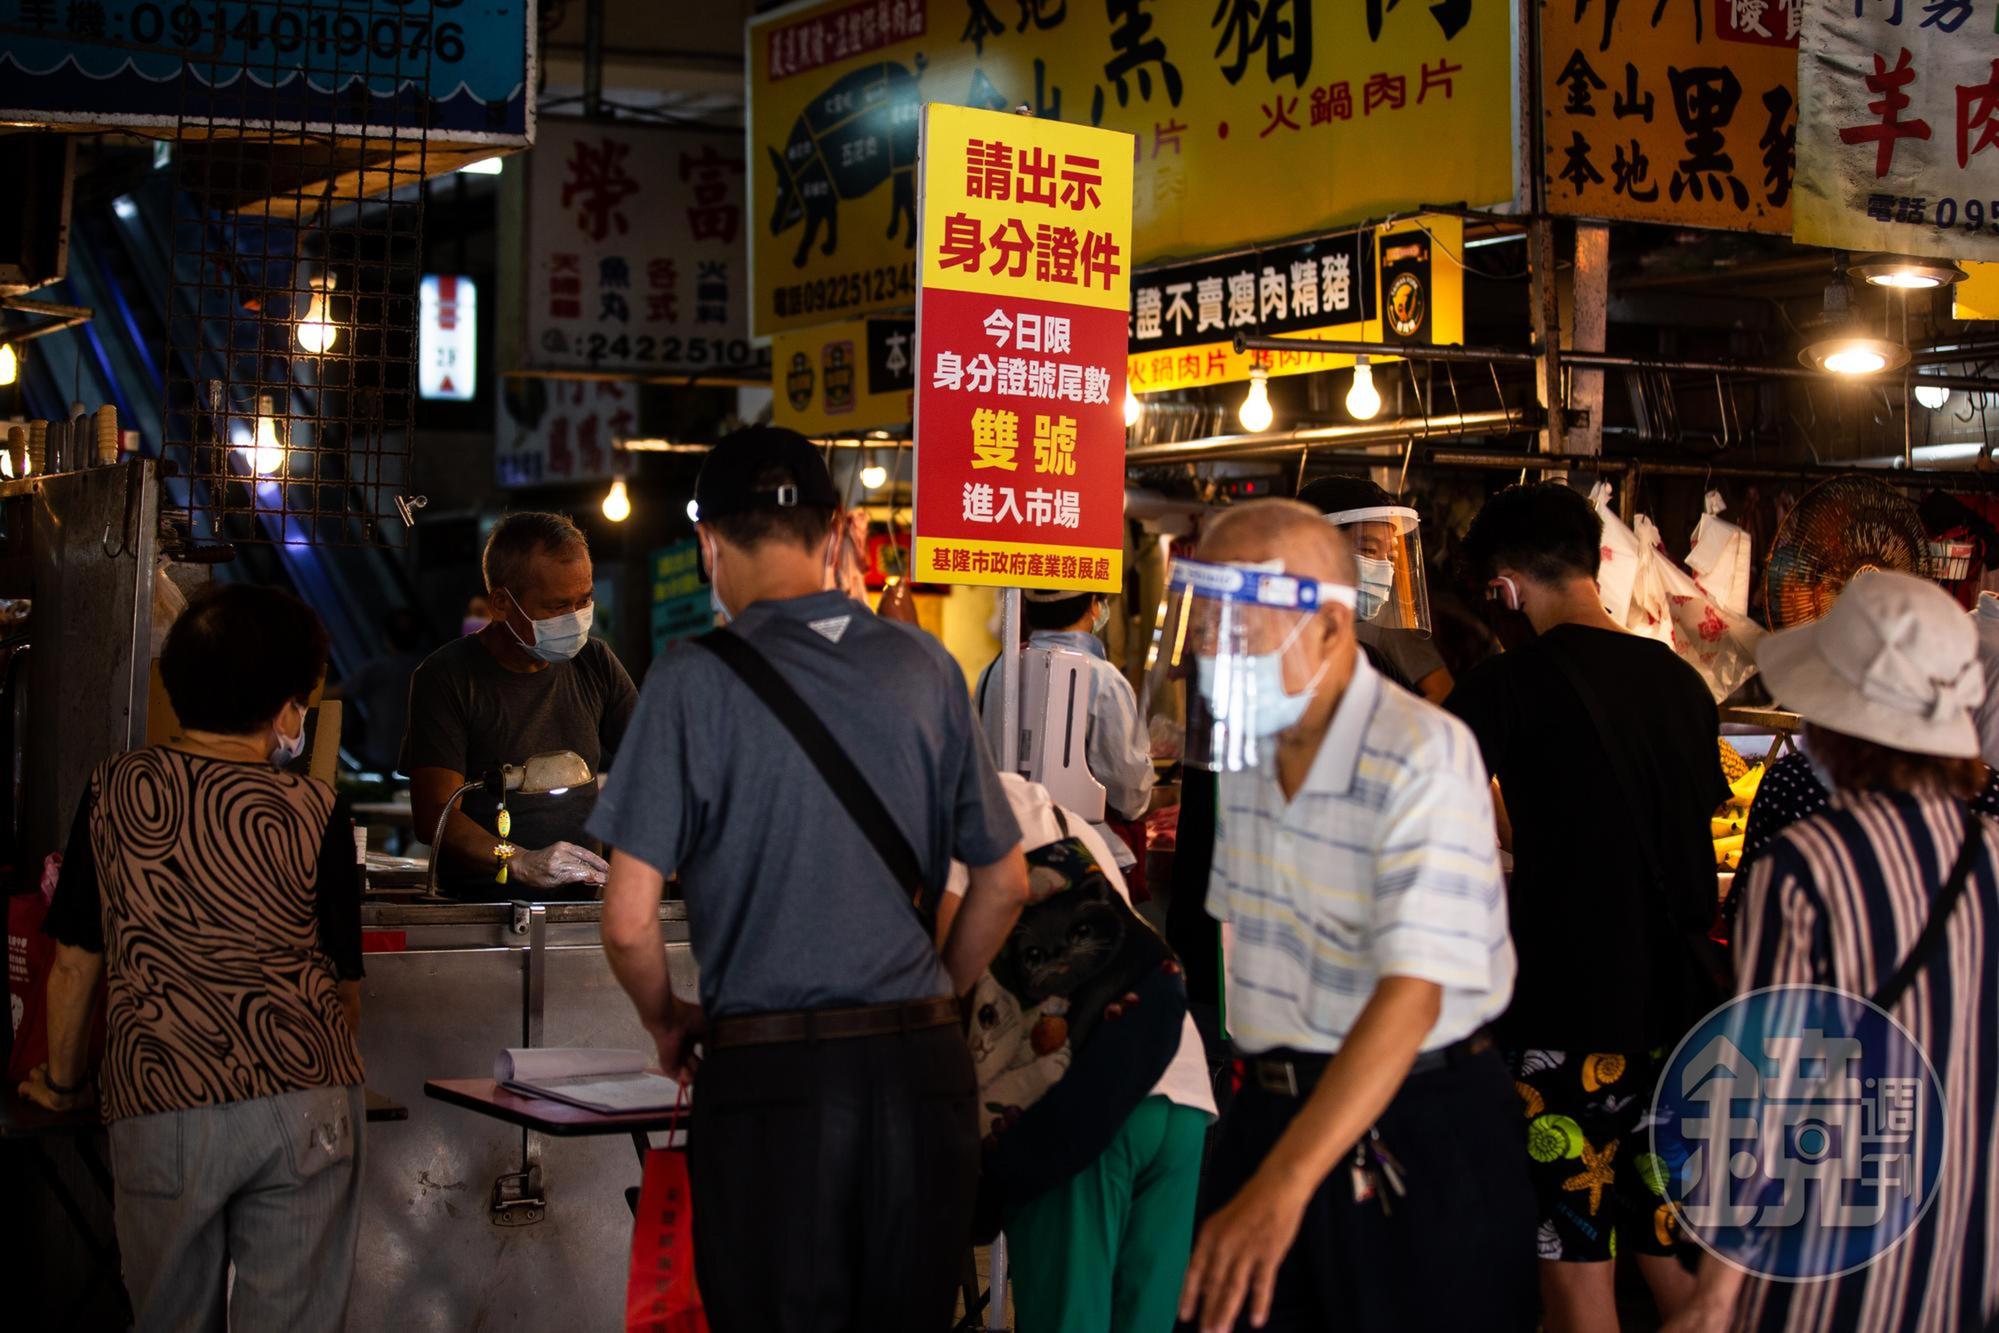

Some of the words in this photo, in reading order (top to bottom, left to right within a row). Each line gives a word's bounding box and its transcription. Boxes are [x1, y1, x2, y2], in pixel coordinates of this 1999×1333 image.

[1135, 118, 1188, 162] 片
[1260, 58, 1463, 139] 火鍋肉片
[1556, 48, 1655, 123] 金山
[966, 138, 1102, 211] 請出示
[1558, 130, 1660, 202] 本地
[1867, 194, 1926, 224] 電話
[938, 212, 1121, 291] 身分證件
[598, 256, 630, 322] 魚丸
[647, 257, 678, 323] 各式
[884, 327, 917, 380] 本
[1128, 252, 1351, 342] 證不賣瘦肉精豬
[983, 308, 1072, 355] 今日限
[933, 352, 1110, 405] 身分證號尾數
[970, 407, 1078, 476] 雙號
[962, 482, 1080, 529] 進入市場
[932, 547, 1110, 580] 基隆市政府產業發展處
